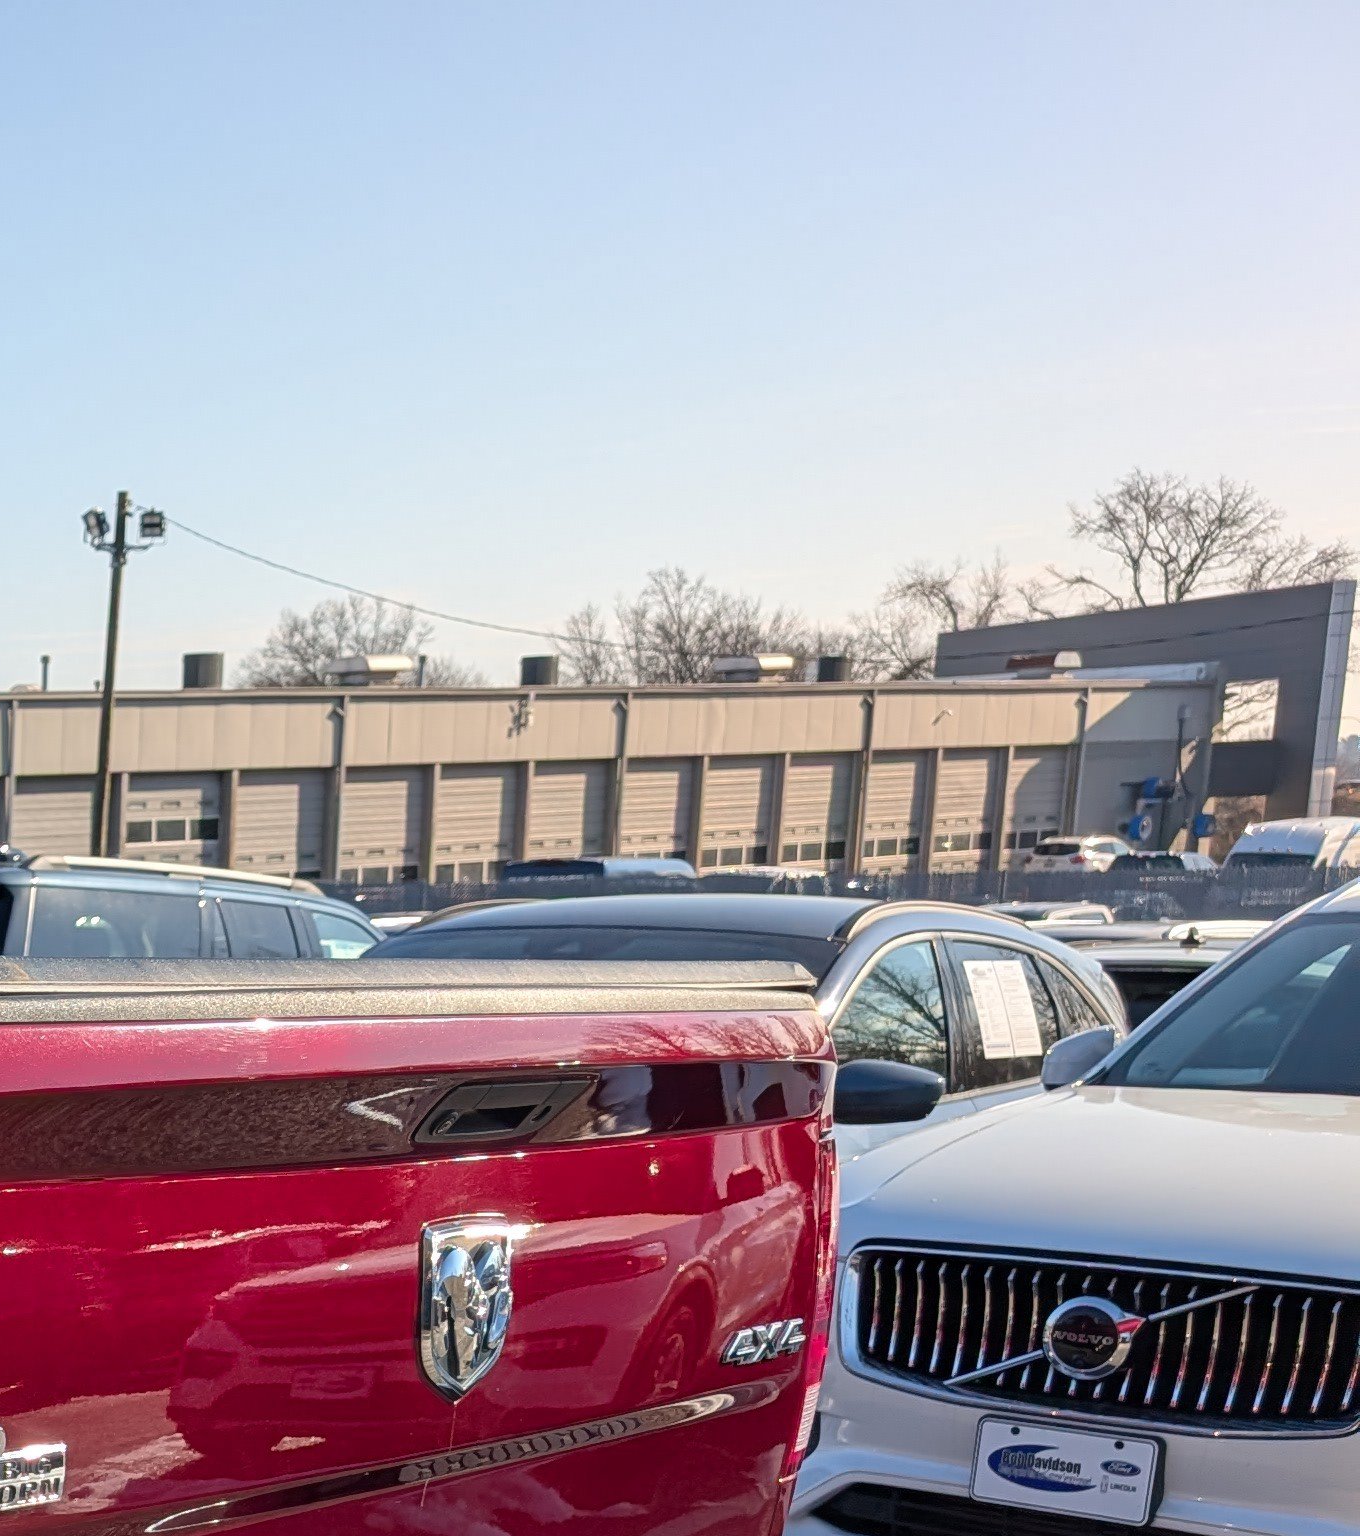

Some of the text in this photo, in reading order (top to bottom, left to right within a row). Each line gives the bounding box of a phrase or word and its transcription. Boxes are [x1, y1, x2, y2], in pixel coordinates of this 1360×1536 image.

[1053, 1329, 1114, 1346] VOLVO
[0, 1456, 53, 1481] BIG
[1027, 1453, 1081, 1475] Davidson
